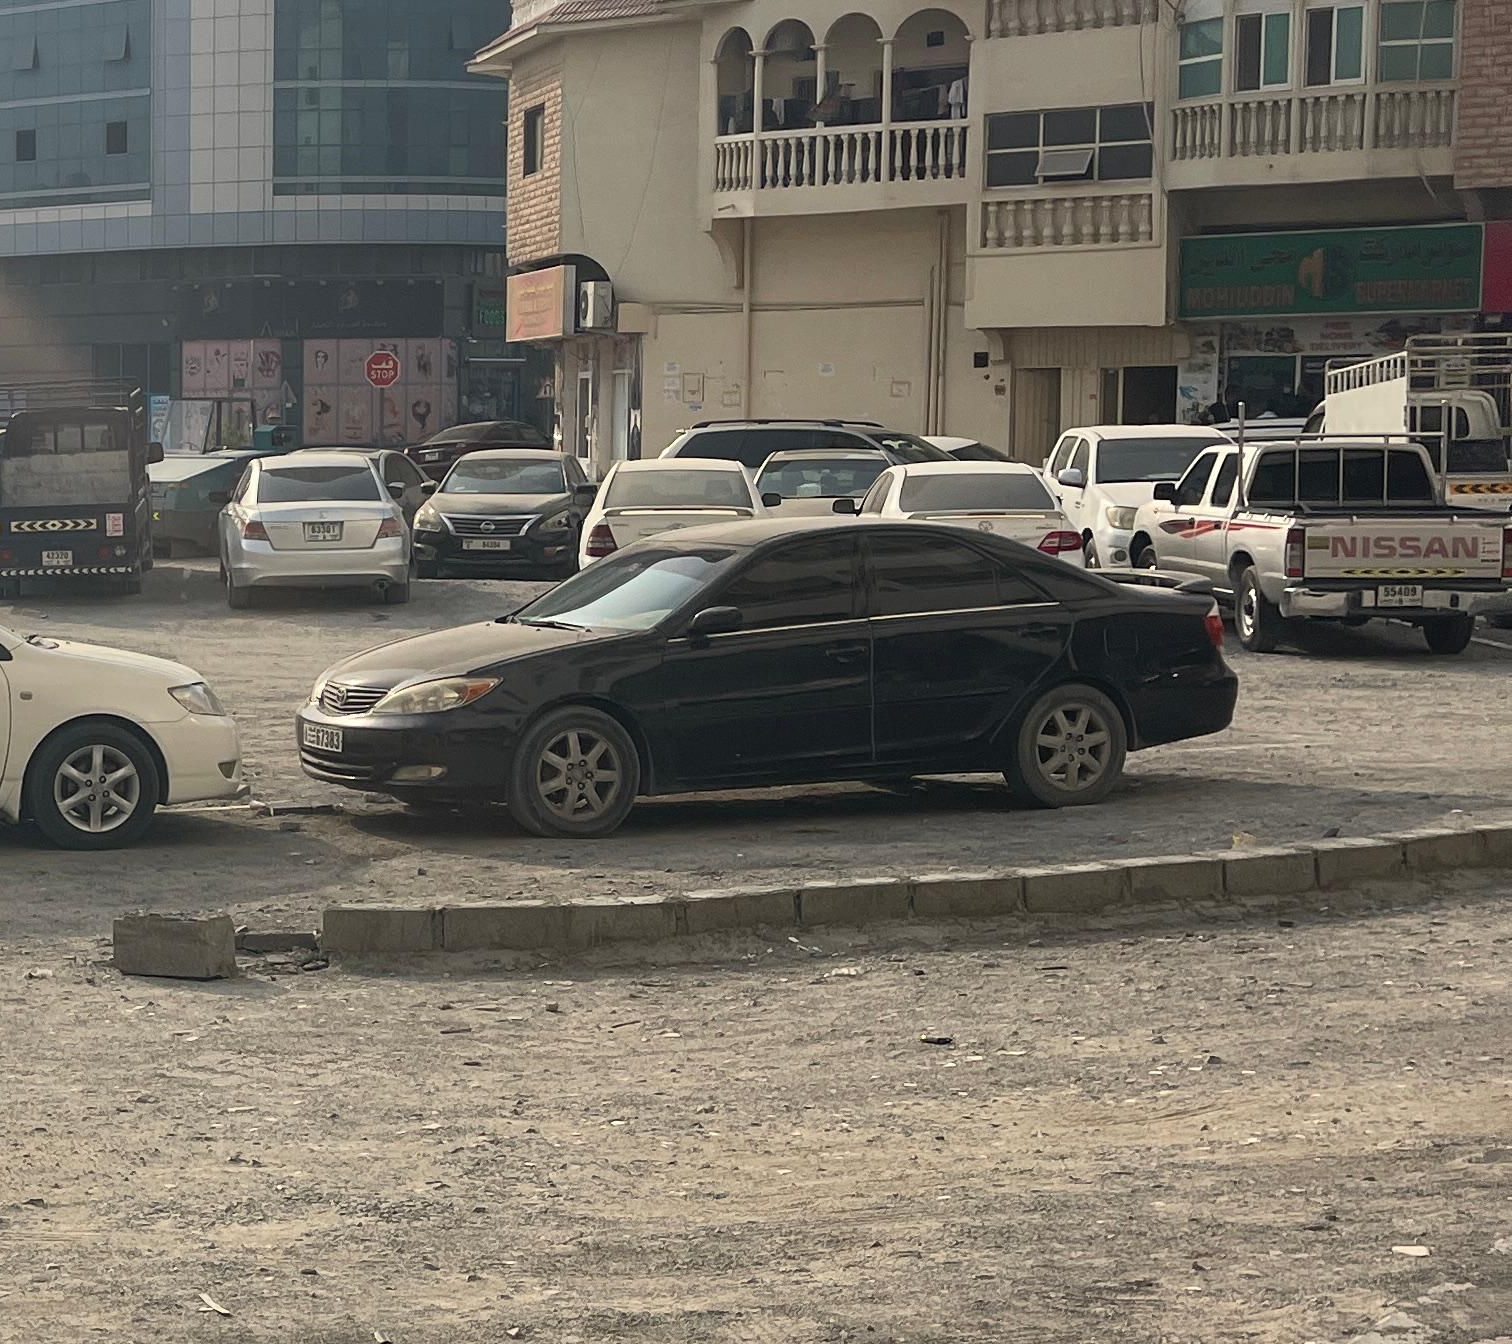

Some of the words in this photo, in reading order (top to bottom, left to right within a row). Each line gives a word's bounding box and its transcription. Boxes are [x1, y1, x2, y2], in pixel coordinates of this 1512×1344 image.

[1354, 277, 1474, 306] SUPERMARKET
[1309, 341, 1365, 352] DELIVERY
[371, 356, 394, 369] قف
[370, 369, 394, 380] STOP
[1331, 535, 1479, 559] NISSAN
[1383, 586, 1417, 597] 55409
[316, 728, 340, 750] 67383
